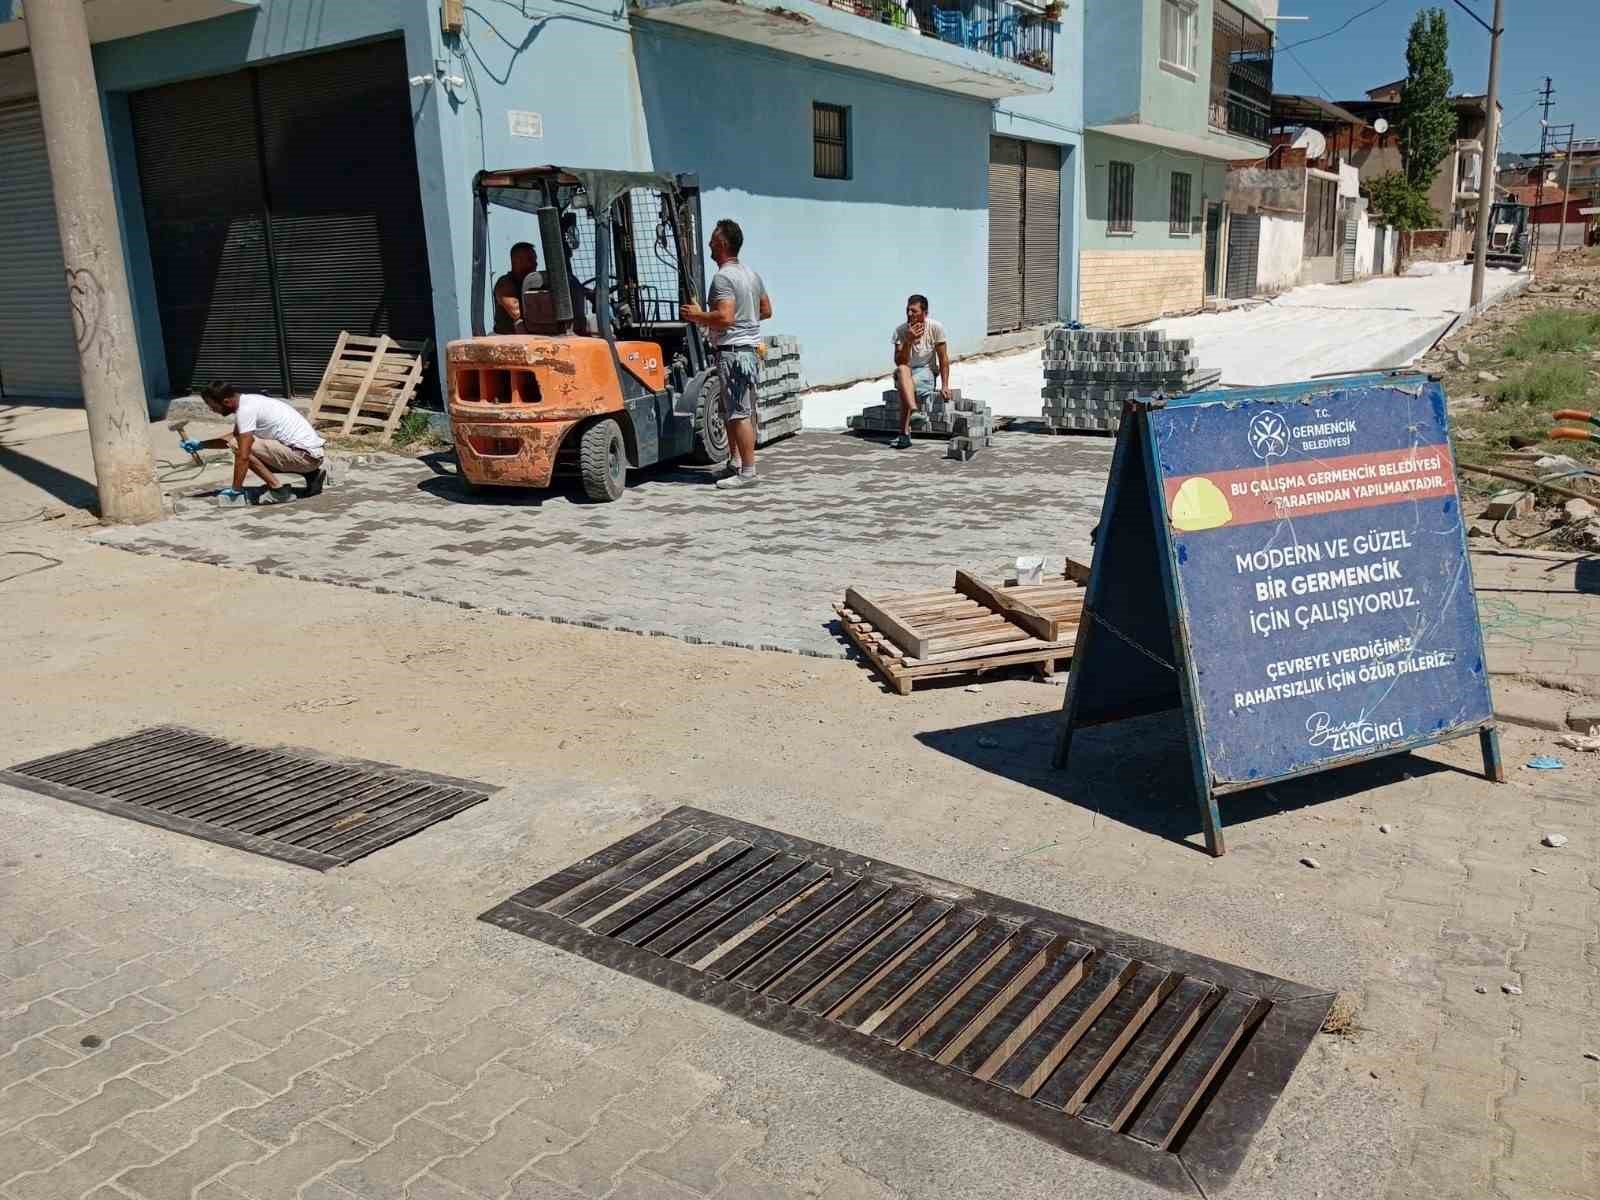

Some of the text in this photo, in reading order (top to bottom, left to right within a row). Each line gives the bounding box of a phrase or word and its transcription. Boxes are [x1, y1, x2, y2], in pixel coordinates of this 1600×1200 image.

[1292, 418, 1357, 439] GERMENCİK
[1302, 435, 1351, 451] BELEDİYESİ
[1231, 454, 1441, 496] BU ÇALIŞMA GERMENCİK BELEDİYESİ
[1352, 476, 1446, 500] YAPILMAKTADIR.
[1235, 529, 1412, 574] MODERN VE GÜZEL
[1255, 556, 1403, 602] BİR GERMENCİK
[1250, 587, 1421, 638] İÇİN ÇALIŞIYORUZ.
[1234, 676, 1325, 709] RAHATSIZLIK
[1327, 668, 1357, 693] İÇİN
[1358, 657, 1396, 683] ÖZÜR
[1266, 652, 1331, 682] ÇEVREYE
[1332, 718, 1404, 752] ZENCİRCİ
